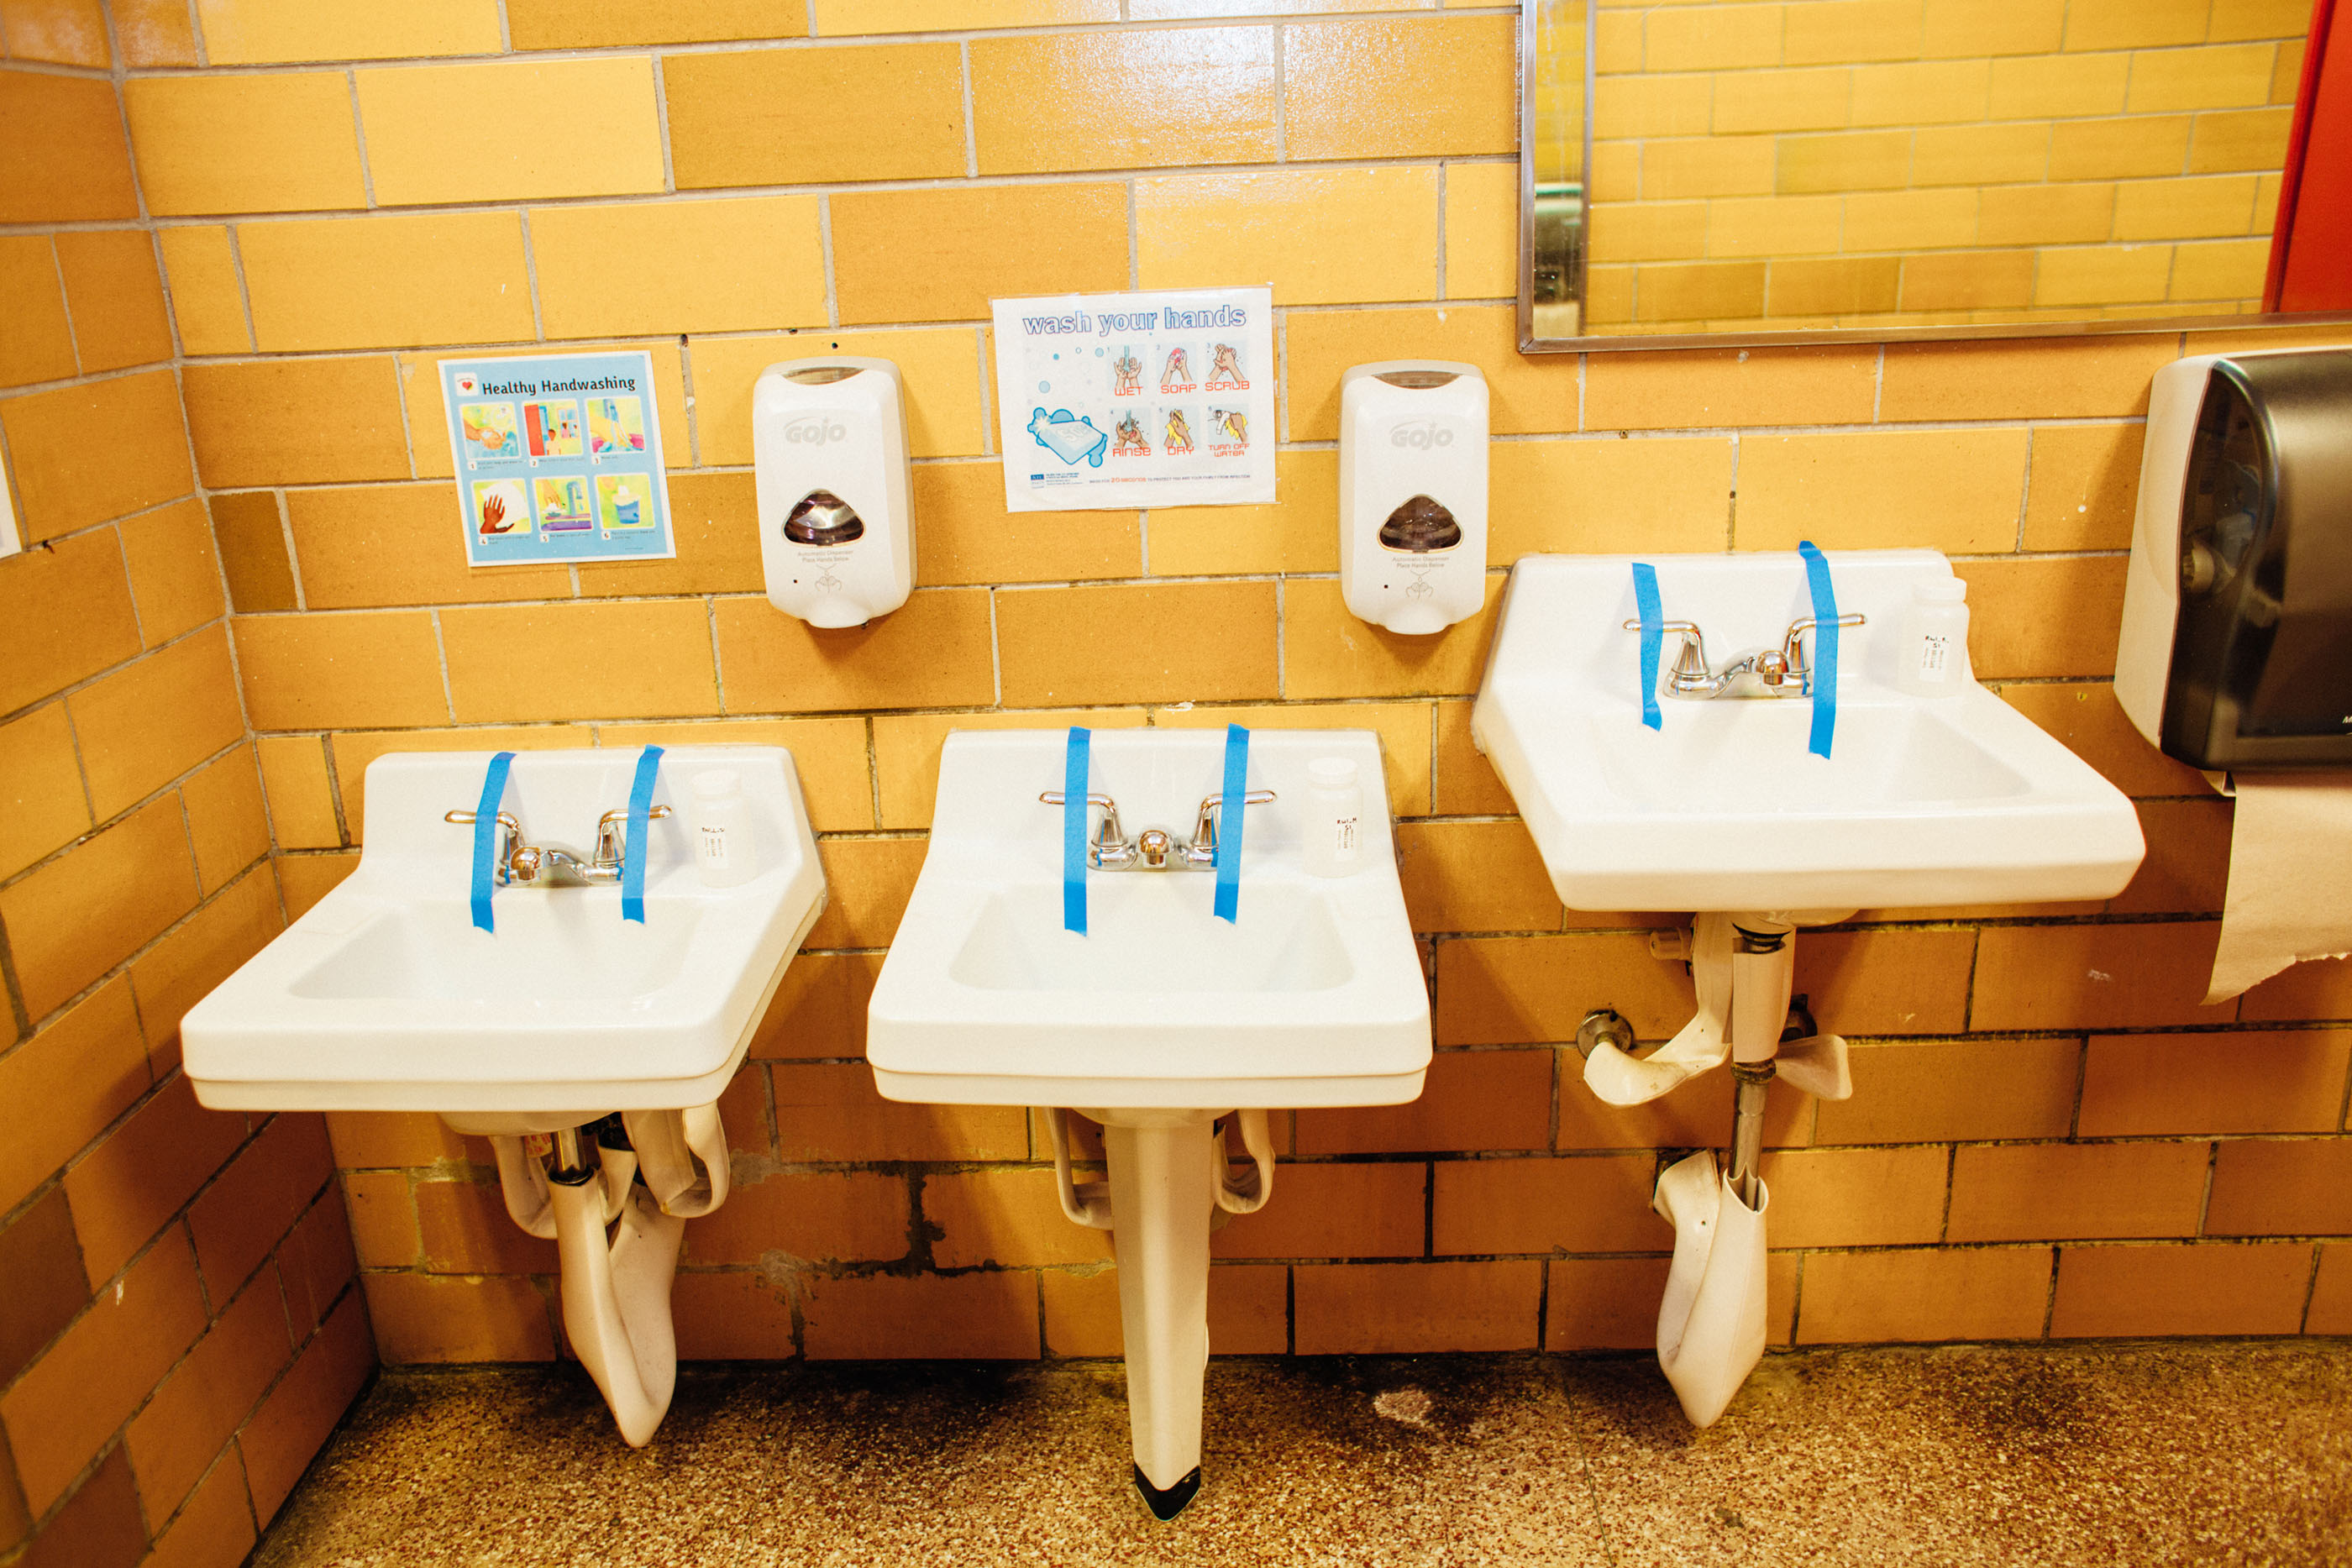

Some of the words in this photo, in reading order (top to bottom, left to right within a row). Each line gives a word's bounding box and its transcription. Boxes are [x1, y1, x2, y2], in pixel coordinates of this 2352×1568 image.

[1022, 311, 1092, 335] wash
[1097, 311, 1158, 337] your
[1164, 305, 1247, 329] hands
[482, 380, 537, 396] Healthy
[542, 376, 636, 393] Handwashing
[1161, 384, 1197, 394] SOAP
[1205, 380, 1250, 391] SCRUB
[1115, 386, 1143, 396] WET
[1168, 445, 1194, 455] DRY
